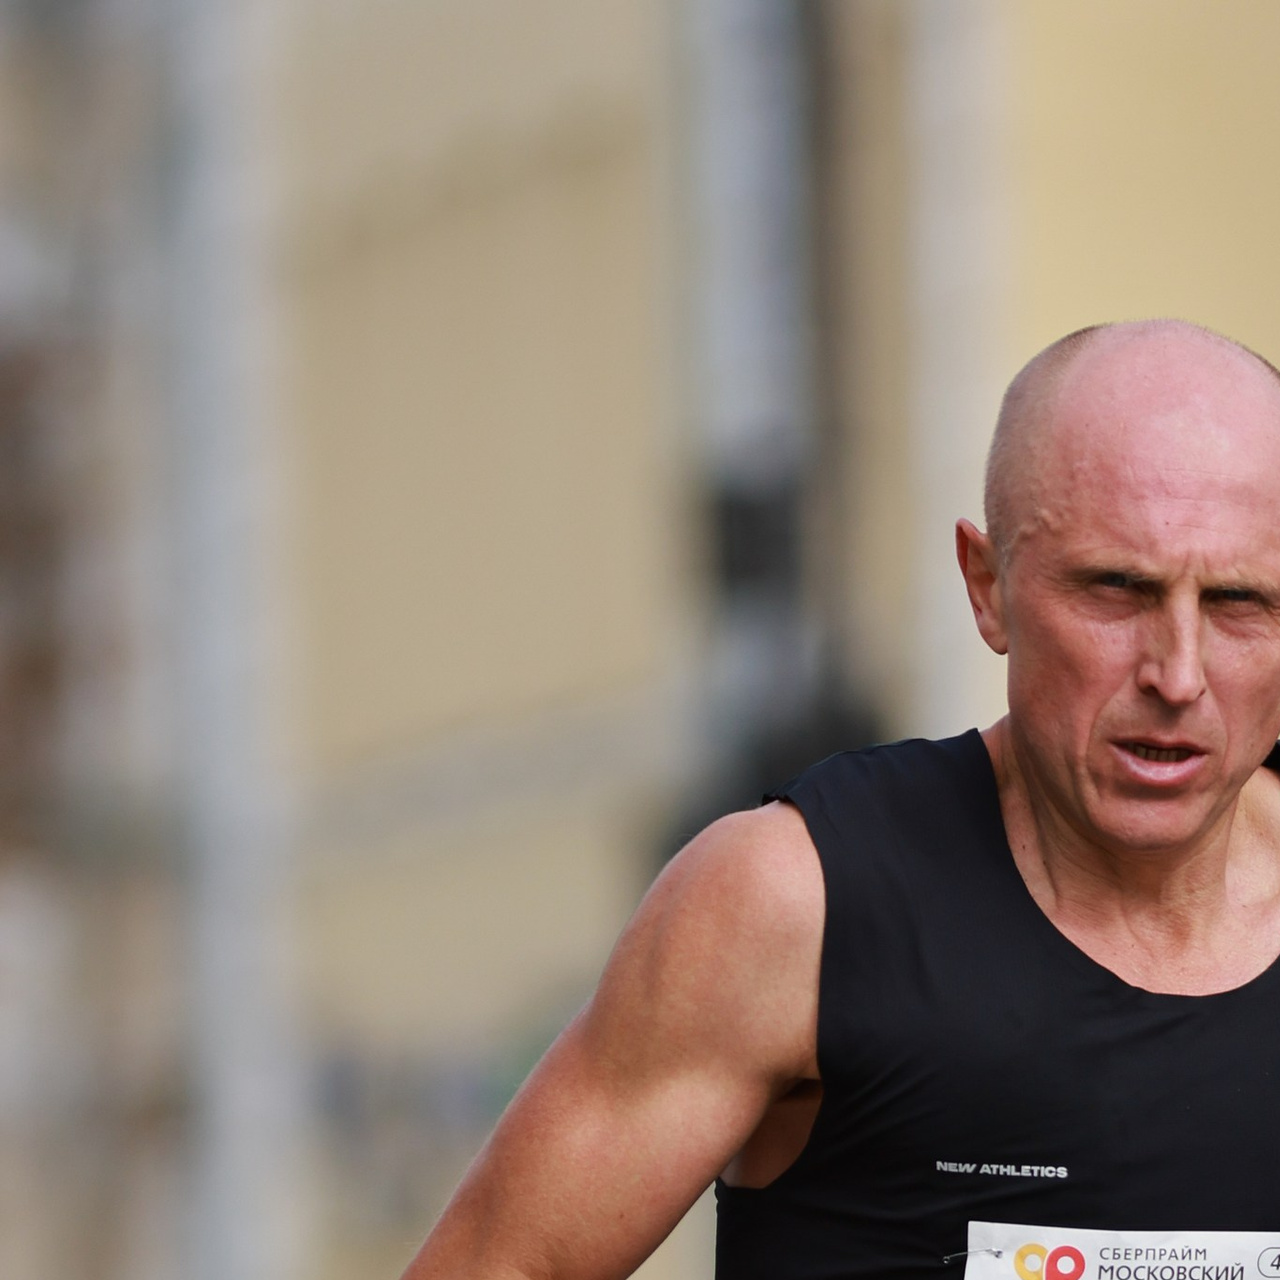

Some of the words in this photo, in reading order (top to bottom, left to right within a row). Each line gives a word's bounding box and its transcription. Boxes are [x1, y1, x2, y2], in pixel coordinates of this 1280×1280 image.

[936, 1160, 977, 1174] NEW
[979, 1163, 1068, 1178] ATHLETICS
[1099, 1245, 1207, 1261] СБЕРПРАЙМ
